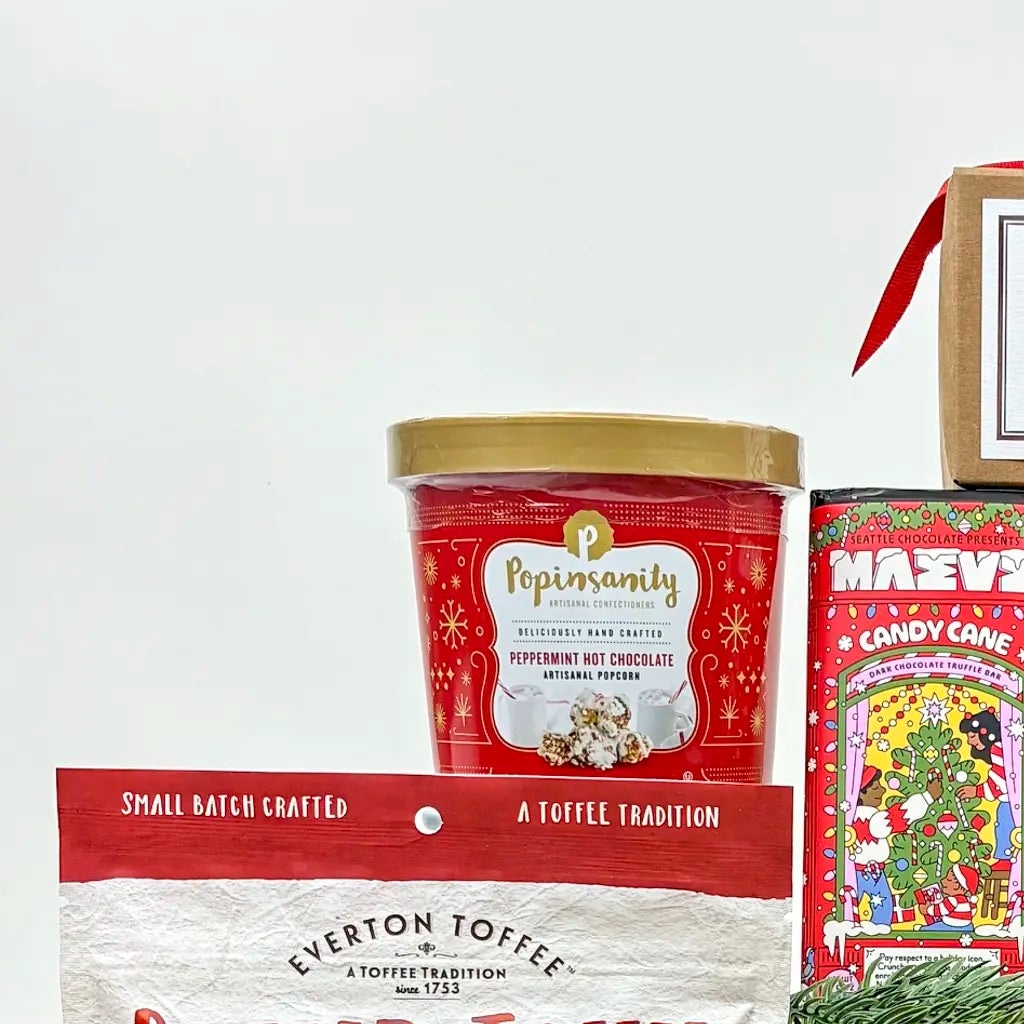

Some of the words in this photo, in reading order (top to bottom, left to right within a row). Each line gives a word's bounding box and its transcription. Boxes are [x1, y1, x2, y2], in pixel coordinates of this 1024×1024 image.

[850, 533, 894, 545] SEATTLE
[897, 533, 963, 546] CHOCOLATE
[966, 534, 1020, 547] PRESENTS
[505, 556, 682, 609] Popinsanity
[549, 600, 590, 609] ARTISANAL
[593, 600, 655, 610] CONFECTIONERS
[518, 627, 582, 637] DELICIOUSLY
[588, 628, 614, 637] HAND
[620, 629, 663, 638] CRAFTED
[858, 619, 945, 653] CANDY
[947, 620, 1014, 656] CANE
[510, 651, 579, 665] PEPPERMINT
[583, 652, 606, 666] HOT
[610, 653, 674, 667] CHOCOLATE
[543, 670, 593, 680] ARTISANAL
[597, 670, 641, 681] POPCORN
[869, 665, 892, 679] DARK
[894, 661, 944, 672] CHOCOLATE
[947, 662, 983, 675] TRUFFLE
[984, 669, 1002, 681] BAR
[121, 791, 185, 817] SMALL
[192, 793, 256, 819] BATCH
[262, 795, 348, 819] CRAFTED
[517, 801, 530, 824] A
[538, 801, 611, 826] TOFFEE
[618, 803, 720, 828] TRADITION
[288, 912, 433, 977] EVERTON
[452, 914, 565, 977] TOFFEE
[895, 954, 923, 964] respect
[924, 954, 933, 962] to
[346, 966, 356, 979] A
[360, 966, 417, 979] TOFFEE
[421, 967, 507, 980] TRADITION
[395, 983, 420, 995] since
[424, 982, 460, 995] 1753
